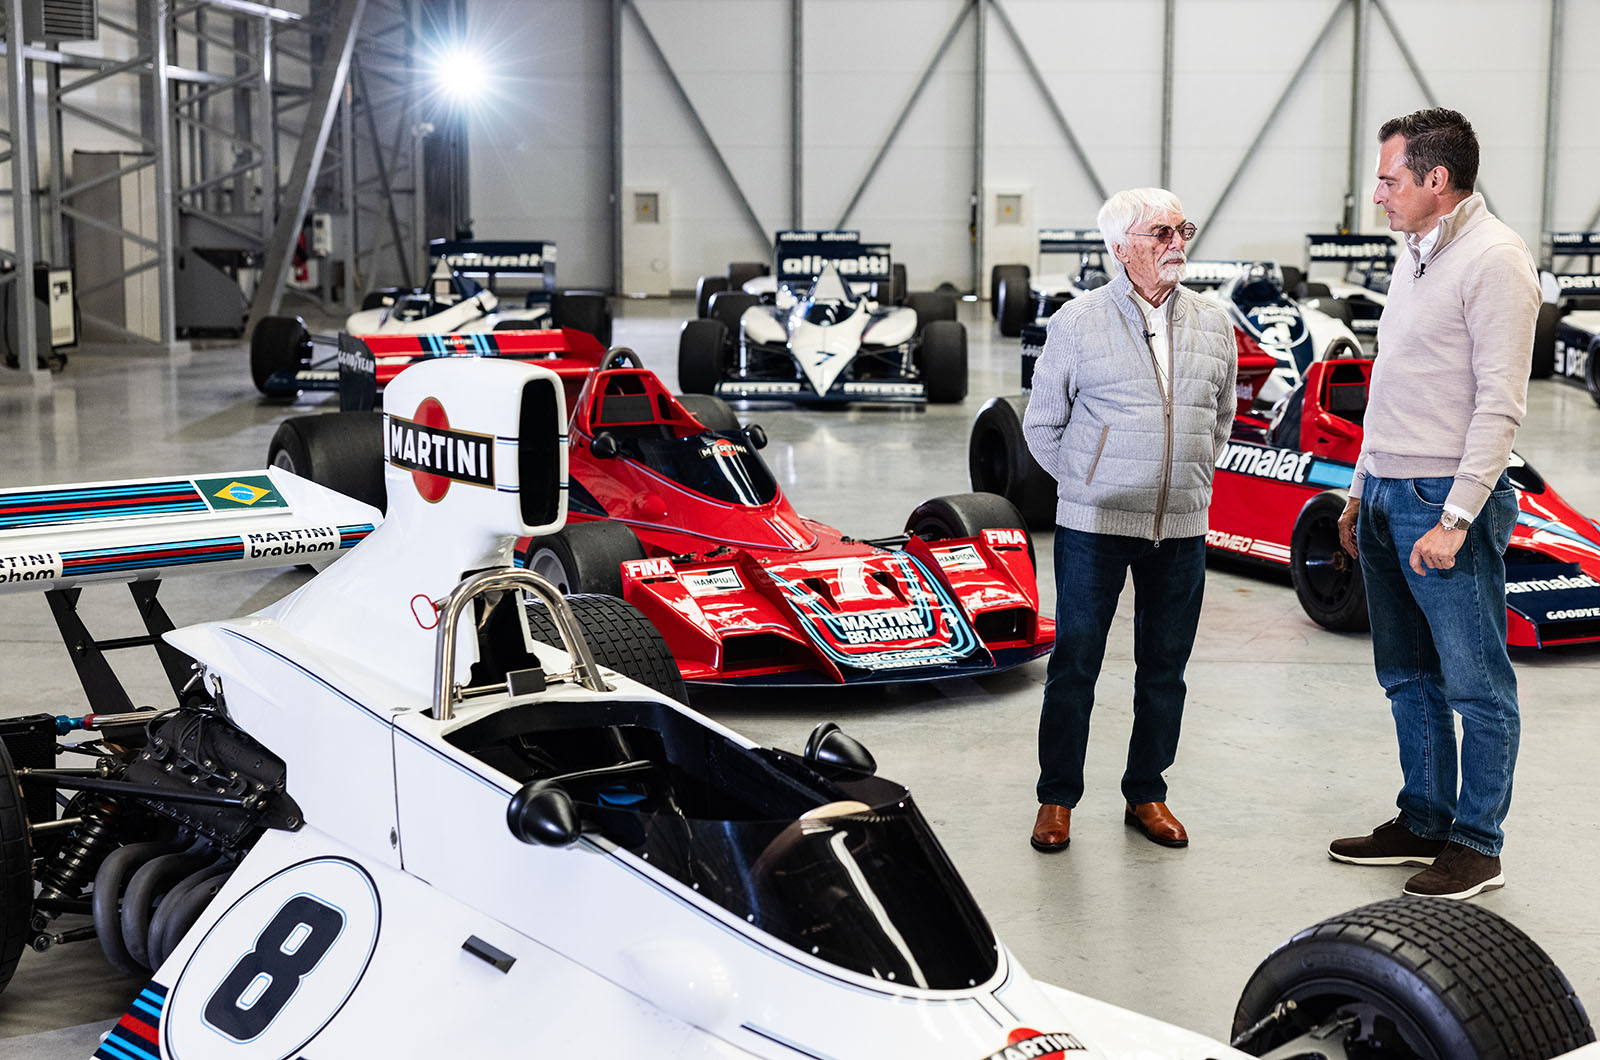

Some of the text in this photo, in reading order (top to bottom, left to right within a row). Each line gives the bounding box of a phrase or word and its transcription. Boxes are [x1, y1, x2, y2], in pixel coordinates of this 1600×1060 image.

[1310, 243, 1388, 257] olivetti
[815, 350, 836, 366] 7
[391, 424, 488, 478] MARTINI
[702, 443, 748, 457] MARTINI
[247, 527, 335, 544] MARTINI
[986, 531, 1027, 544] FINA
[1205, 529, 1252, 552] ROMEO
[250, 541, 335, 558] brabham
[936, 552, 976, 563] HAMPION
[627, 562, 676, 577] FINA
[838, 610, 924, 632] MARTINI
[1546, 608, 1600, 620] GOODYE
[845, 625, 929, 644] BRABHAM
[202, 893, 346, 1044] 8
[991, 1033, 1084, 1060] ARTINI
